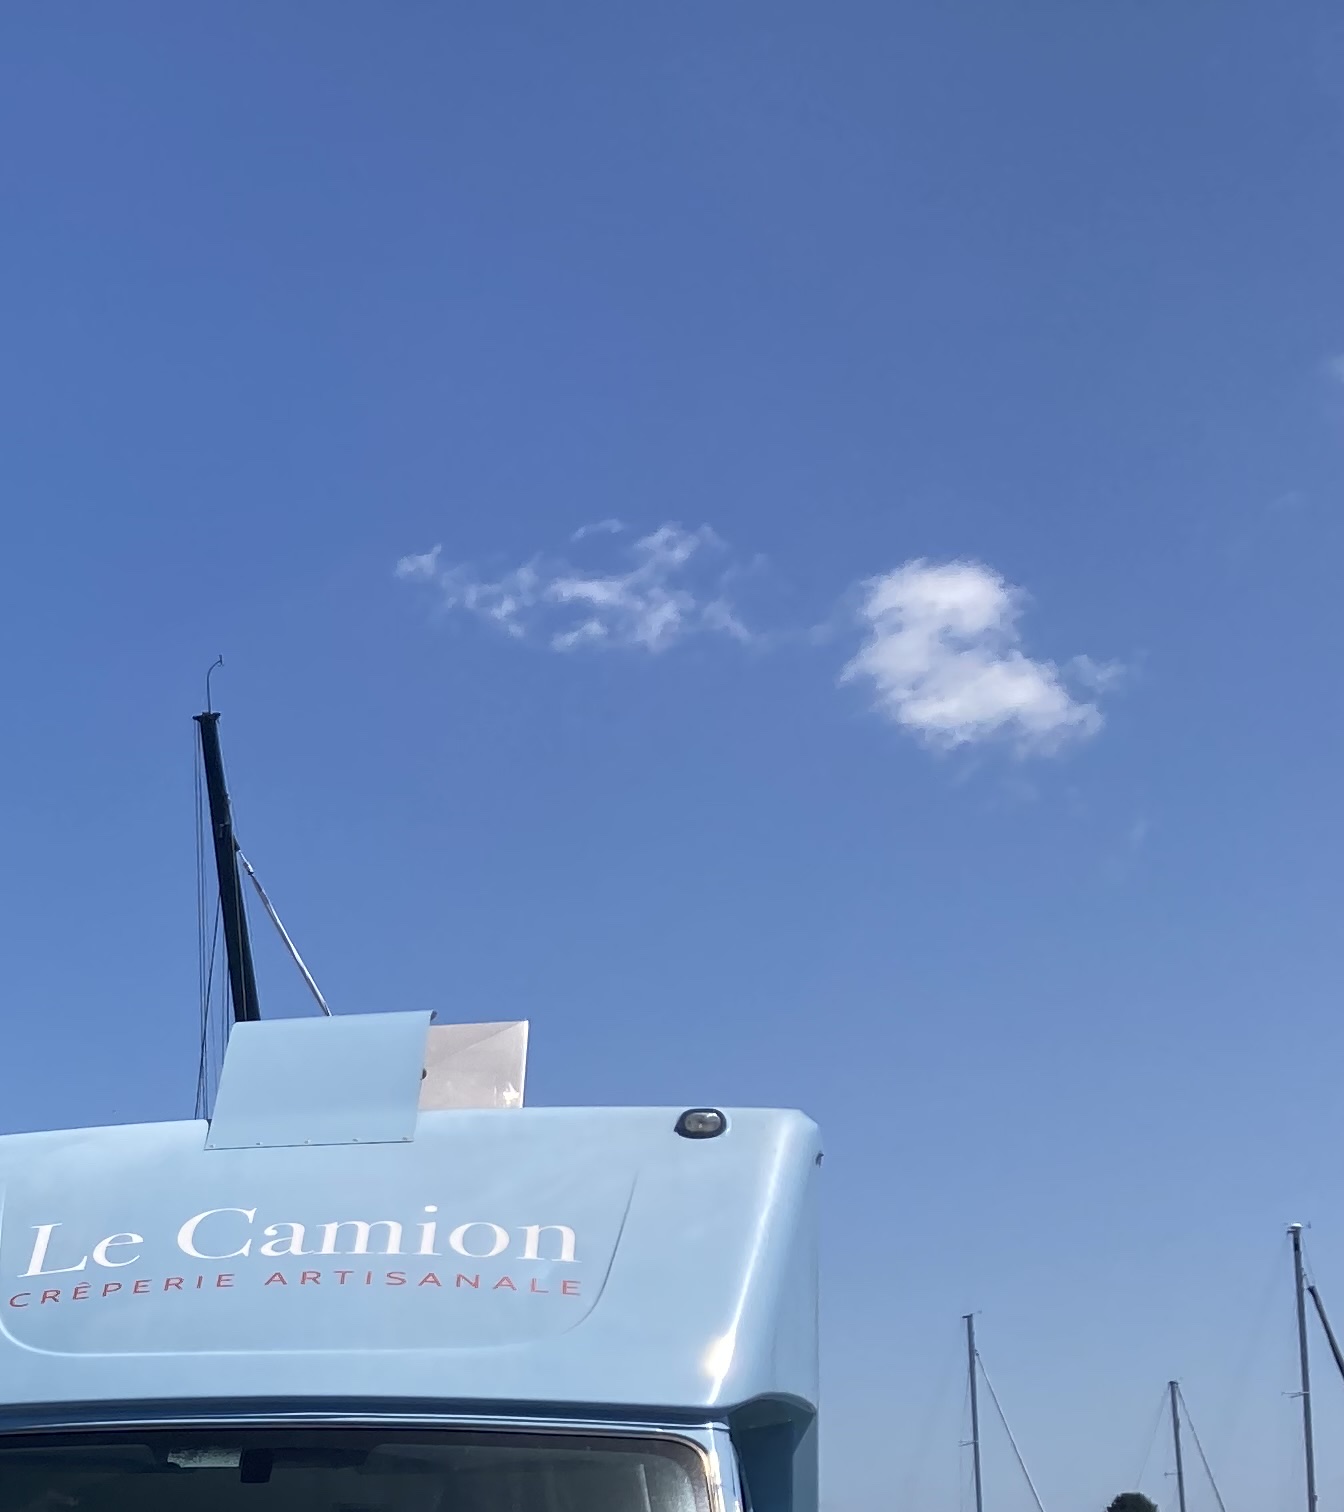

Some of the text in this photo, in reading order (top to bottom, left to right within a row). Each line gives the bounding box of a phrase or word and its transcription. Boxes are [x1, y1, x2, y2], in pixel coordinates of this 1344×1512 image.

[16, 1204, 583, 1278] Le Camion
[9, 1269, 582, 1308] CRÊPERIE ARTISANALE
